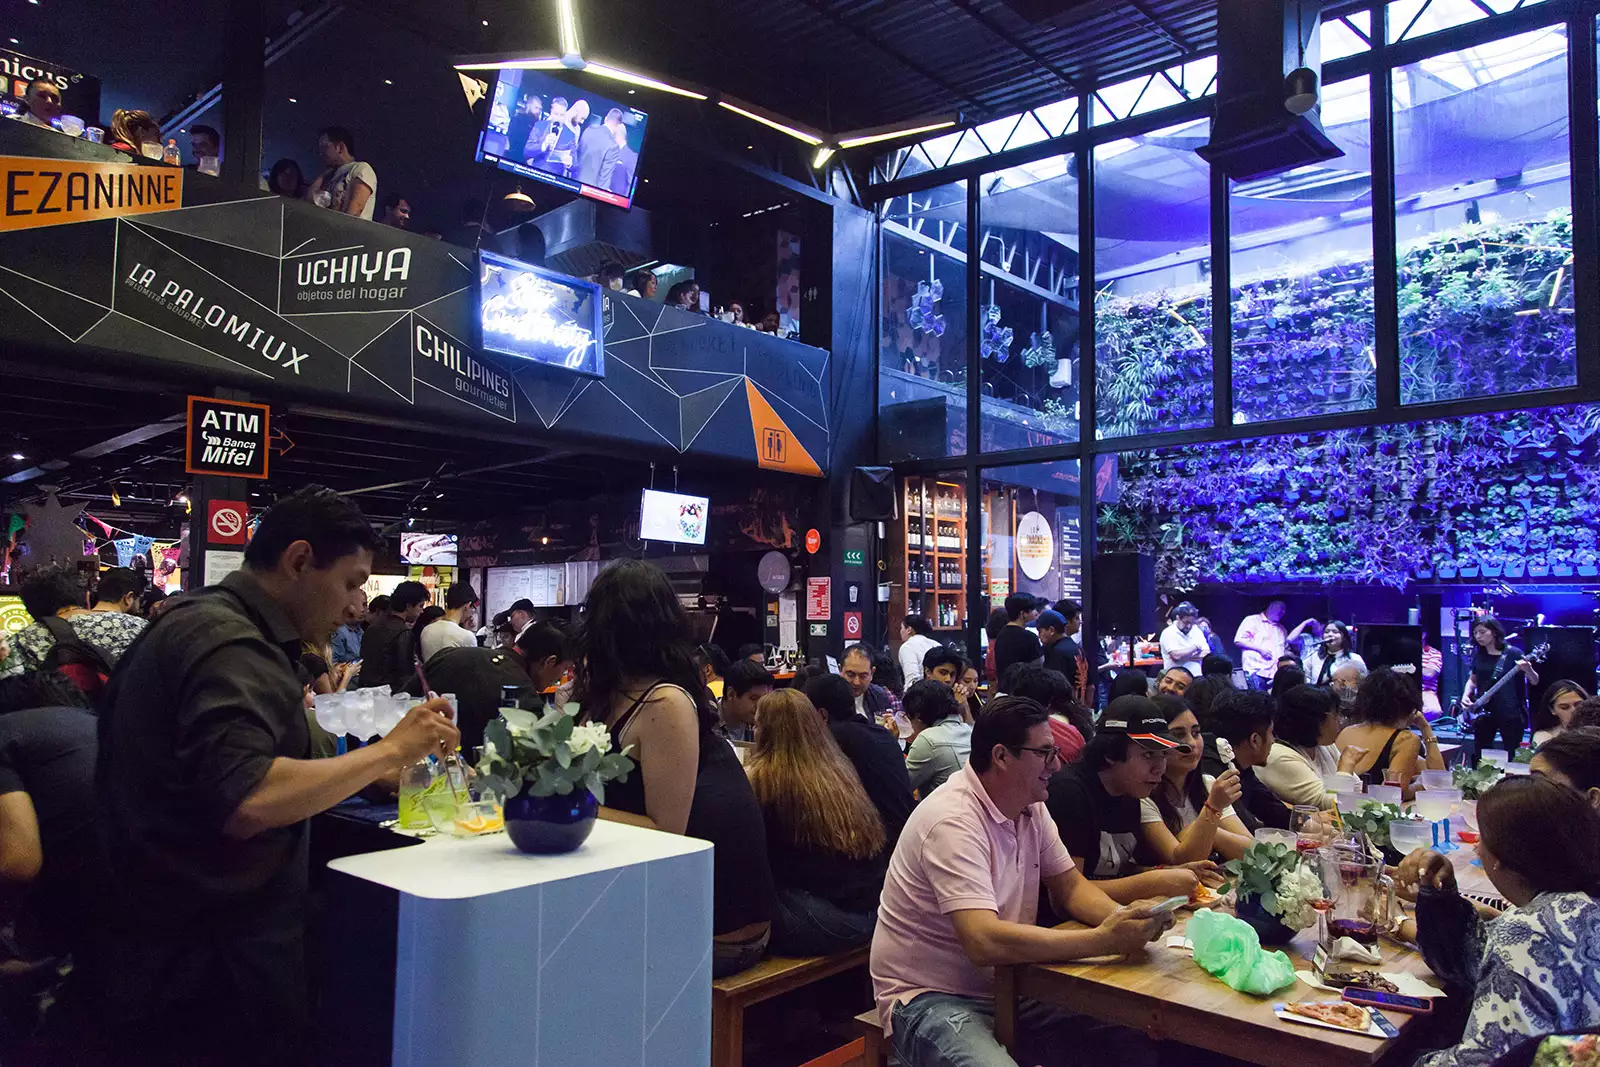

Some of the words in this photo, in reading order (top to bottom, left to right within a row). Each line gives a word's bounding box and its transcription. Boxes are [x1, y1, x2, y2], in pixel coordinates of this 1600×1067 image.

[6, 171, 175, 216] EZANINNE
[297, 247, 412, 286] UCHIYA
[125, 278, 167, 306] PALOMITAS
[166, 301, 208, 330] GOURMET
[297, 288, 333, 302] objetos
[336, 287, 356, 300] del
[360, 286, 408, 301] hogar
[128, 263, 157, 288] LA
[161, 280, 309, 375] PALOMIUX
[416, 325, 509, 398] CHILIPINES
[455, 377, 508, 411] gourmetier
[201, 409, 259, 434] ATM
[201, 445, 254, 467] Mifel
[222, 437, 256, 450] Banca
